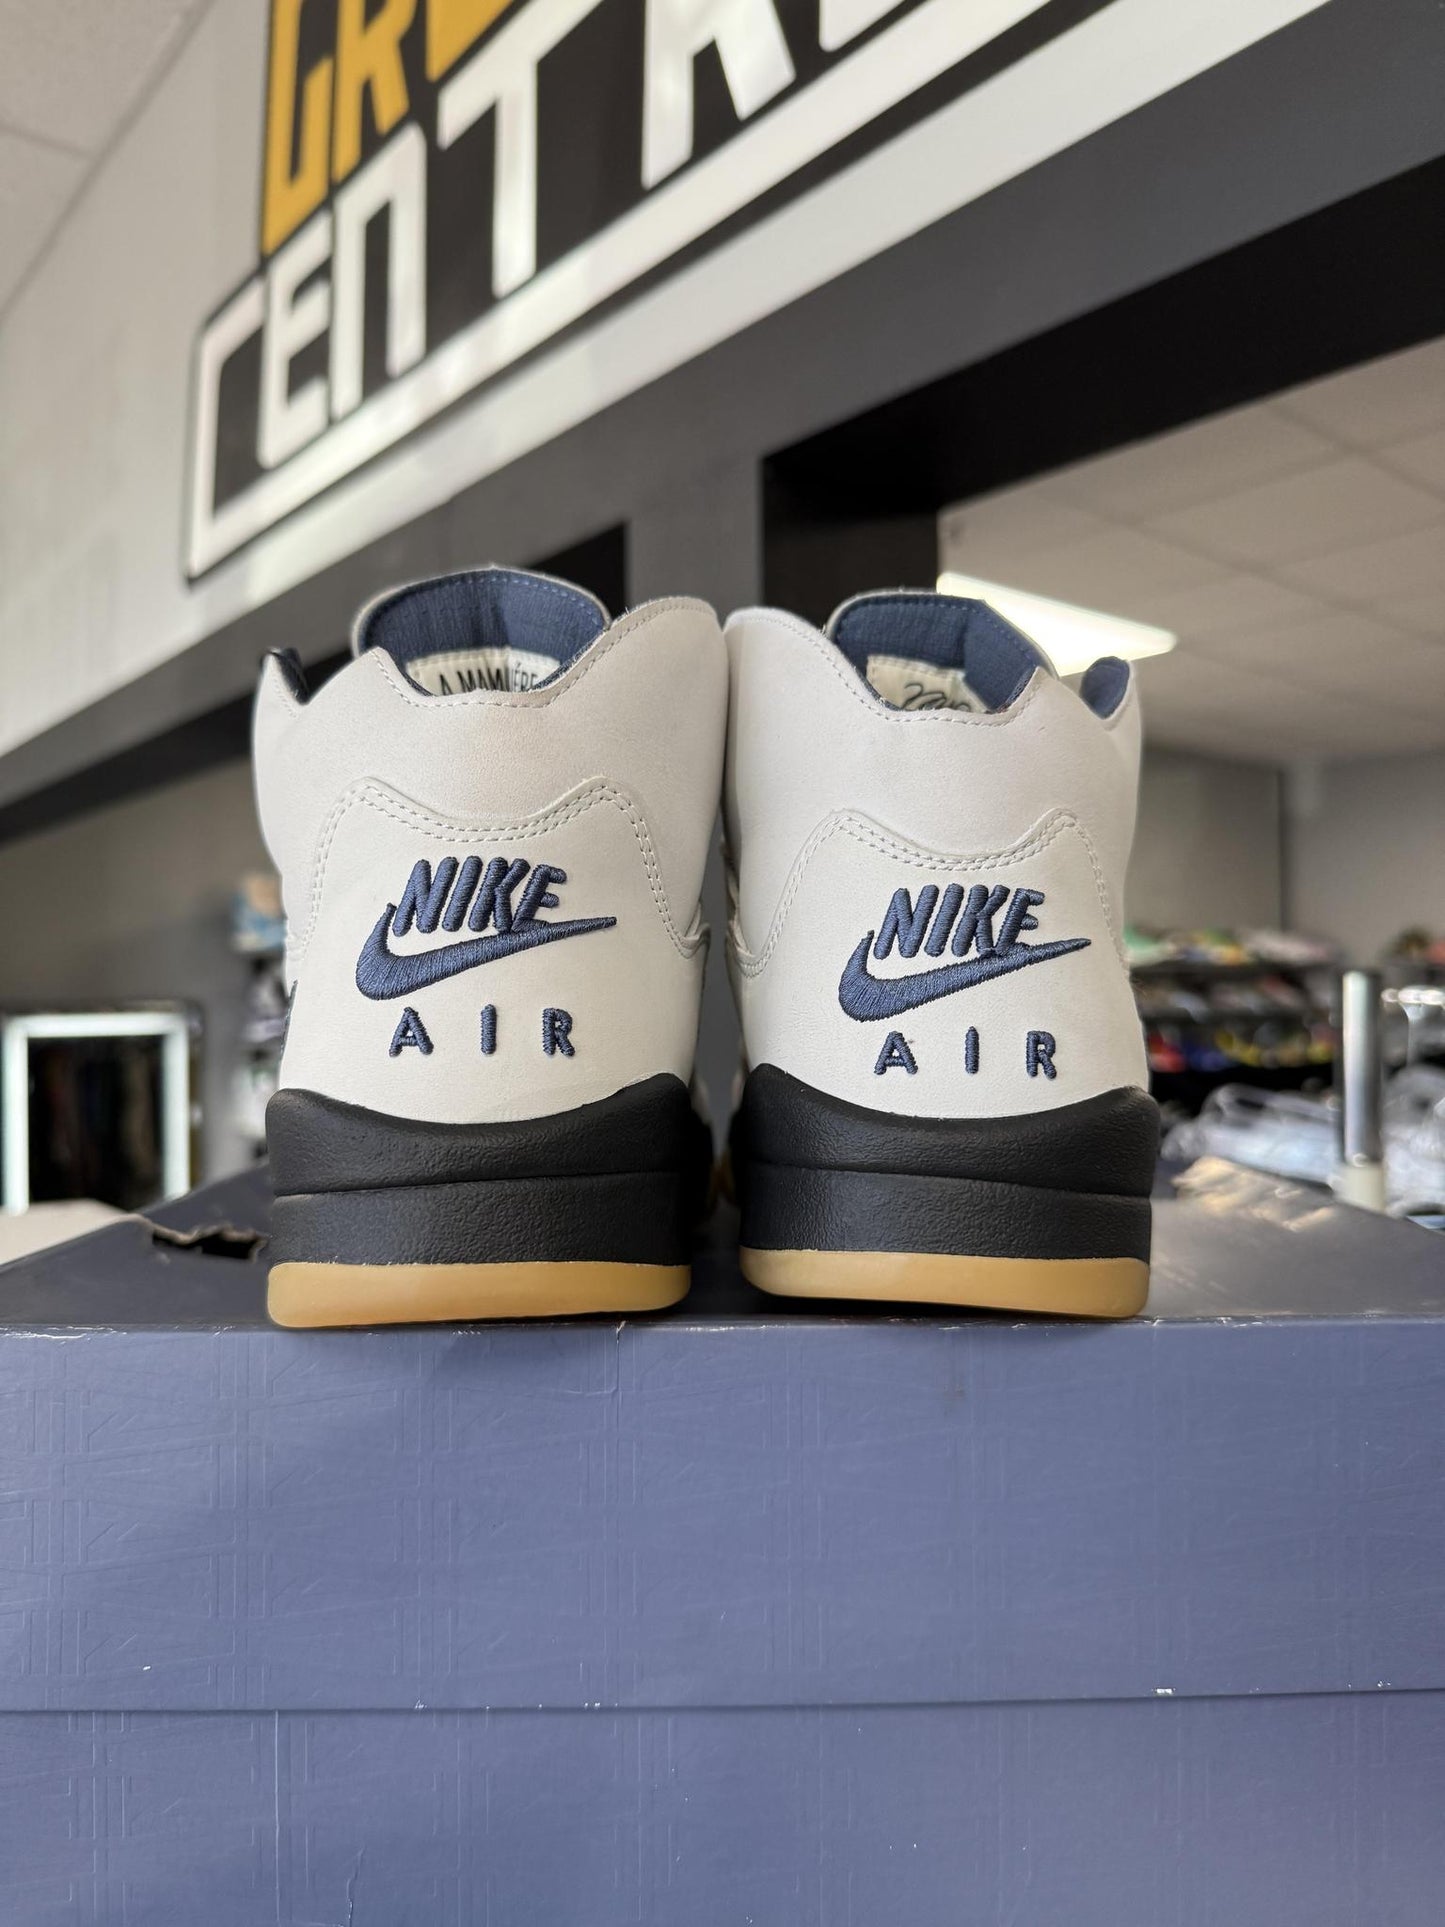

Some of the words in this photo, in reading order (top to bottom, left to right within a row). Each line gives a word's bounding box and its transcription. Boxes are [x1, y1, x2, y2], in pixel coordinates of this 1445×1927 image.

[391, 855, 567, 937] NIKE
[873, 883, 1046, 960] NIKE
[388, 1003, 576, 1058] AIR
[873, 1025, 1058, 1080] AIR
